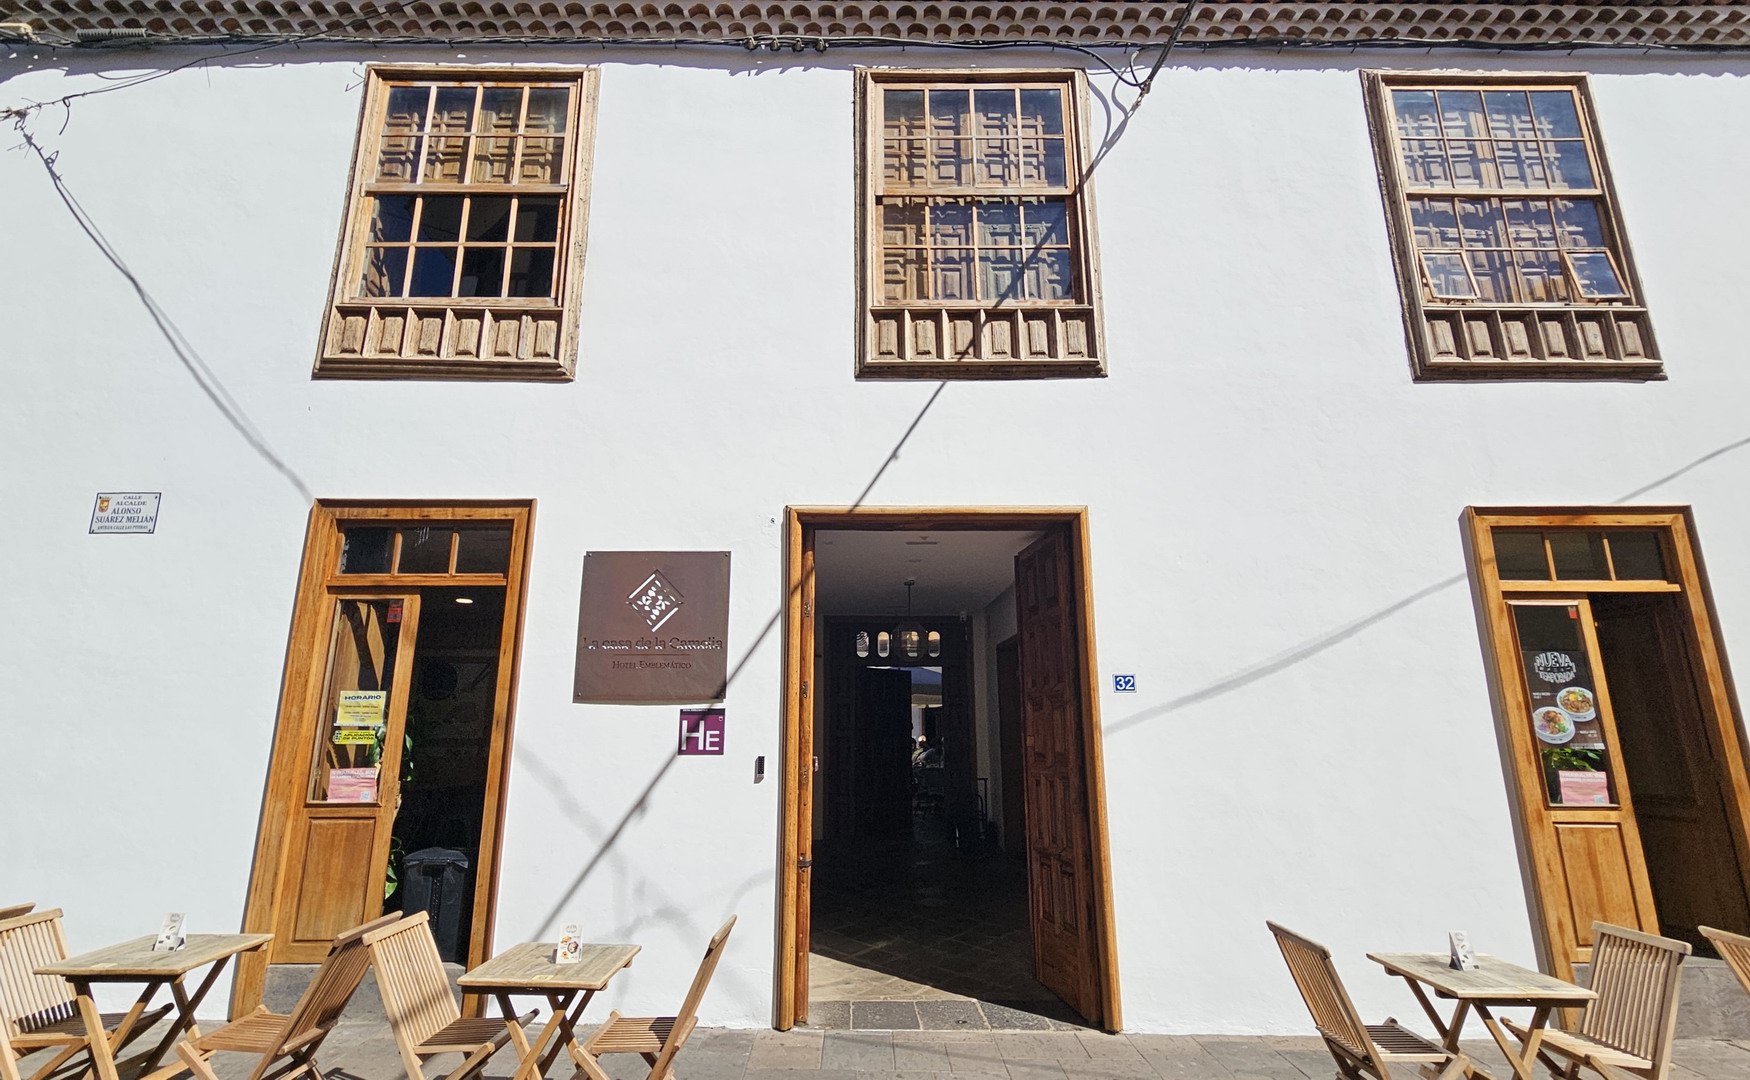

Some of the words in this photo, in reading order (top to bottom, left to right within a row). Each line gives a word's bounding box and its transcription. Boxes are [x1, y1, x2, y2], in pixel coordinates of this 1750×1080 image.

[111, 507, 142, 515] ALONSO
[125, 514, 154, 523] MELIÁN
[583, 637, 599, 649] La
[602, 639, 632, 649] casa
[635, 637, 652, 649] de
[654, 637, 666, 649] la
[1534, 651, 1573, 667] NUEVA
[612, 661, 637, 669] HOTEL
[1116, 676, 1135, 690] 32
